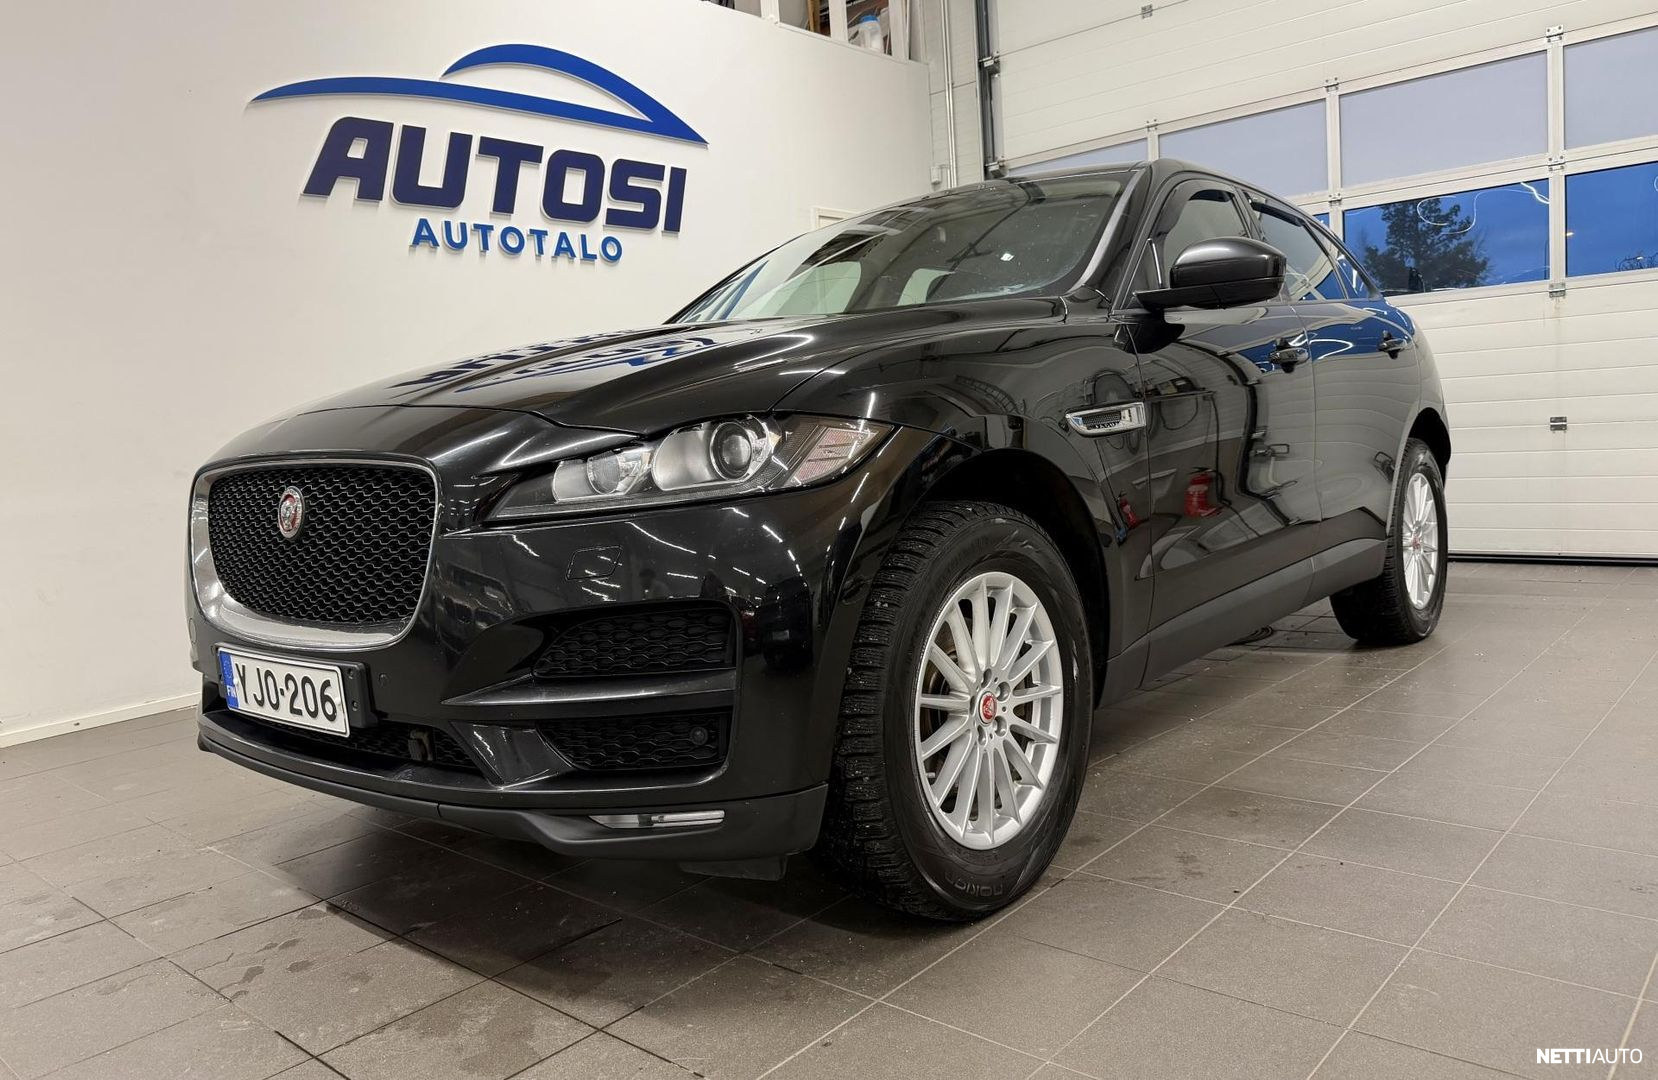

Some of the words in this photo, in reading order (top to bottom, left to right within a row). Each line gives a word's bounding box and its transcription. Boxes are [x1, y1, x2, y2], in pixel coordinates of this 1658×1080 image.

[302, 116, 687, 232] AUTOSI
[412, 217, 623, 263] AUTOTALO
[235, 662, 337, 722] YJO-206
